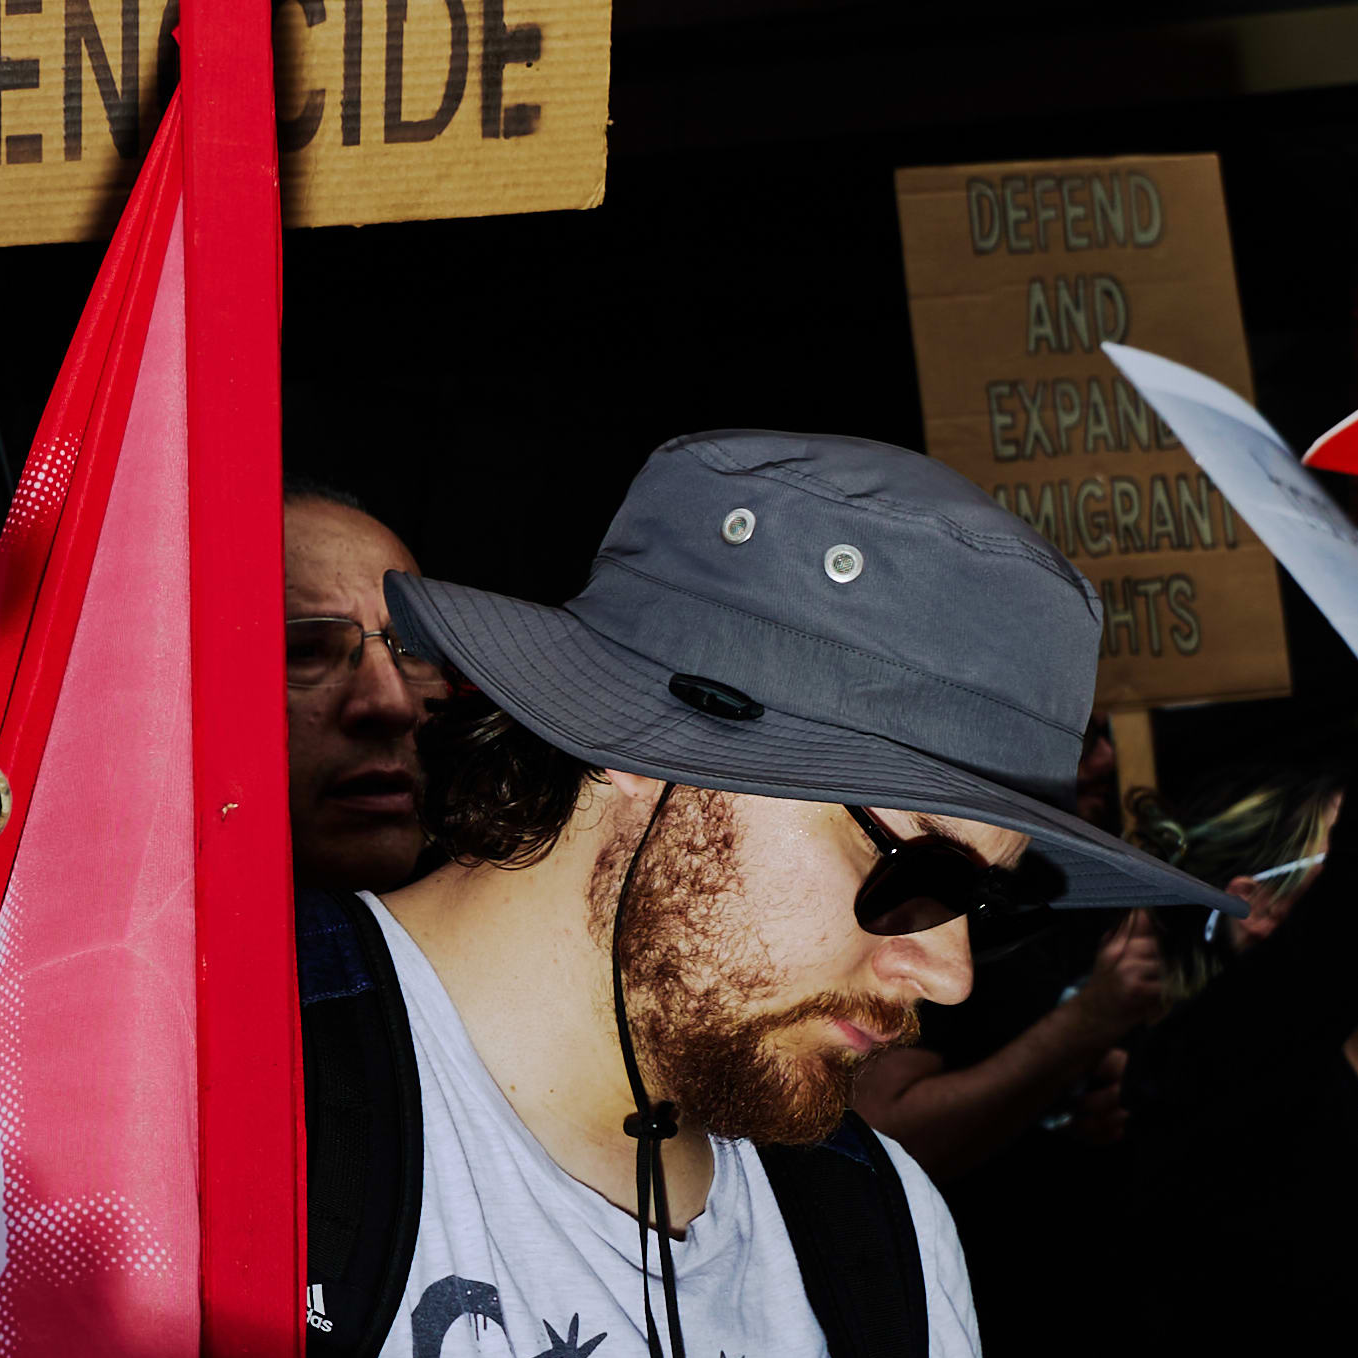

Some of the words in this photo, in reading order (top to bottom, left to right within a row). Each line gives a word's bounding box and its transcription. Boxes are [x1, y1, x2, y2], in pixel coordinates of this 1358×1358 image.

[966, 171, 1166, 256] DEFEND
[1027, 272, 1129, 354] AND
[993, 472, 1238, 557] MIGRAN
